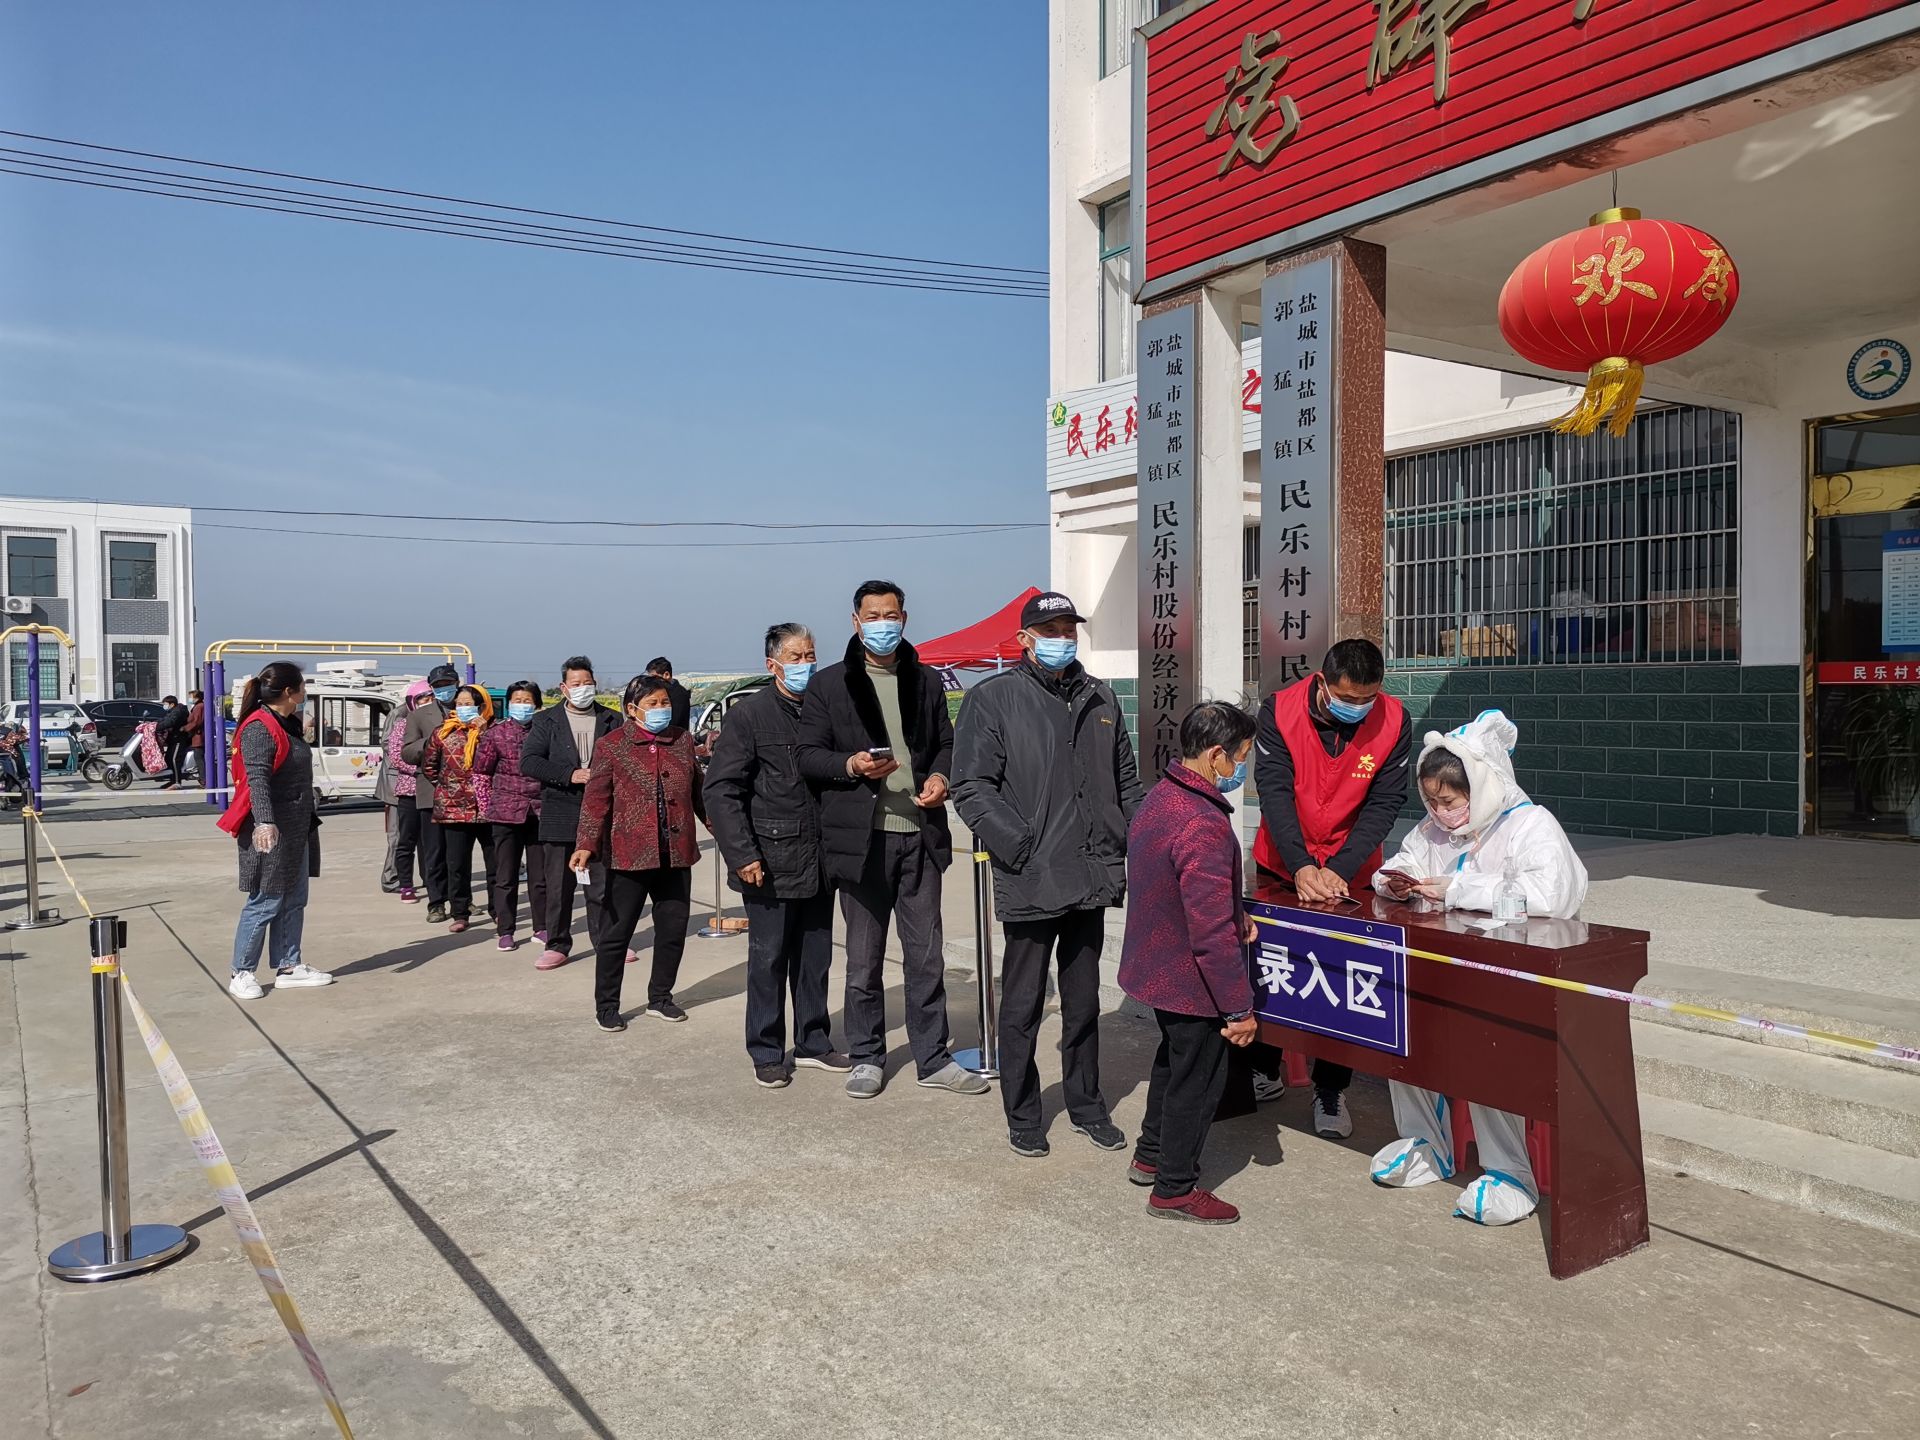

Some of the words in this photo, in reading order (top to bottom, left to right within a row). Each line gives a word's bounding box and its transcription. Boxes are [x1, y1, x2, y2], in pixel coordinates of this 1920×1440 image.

[1146, 339, 1164, 482] 郭猛镇
[1165, 334, 1183, 479] 盐城市盐都区
[1273, 299, 1293, 460] 郭猛镇
[1297, 293, 1318, 455] 盐城市盐都区
[1151, 501, 1179, 782] 民乐村股份经济合作
[1256, 941, 1387, 1019] 录入区
